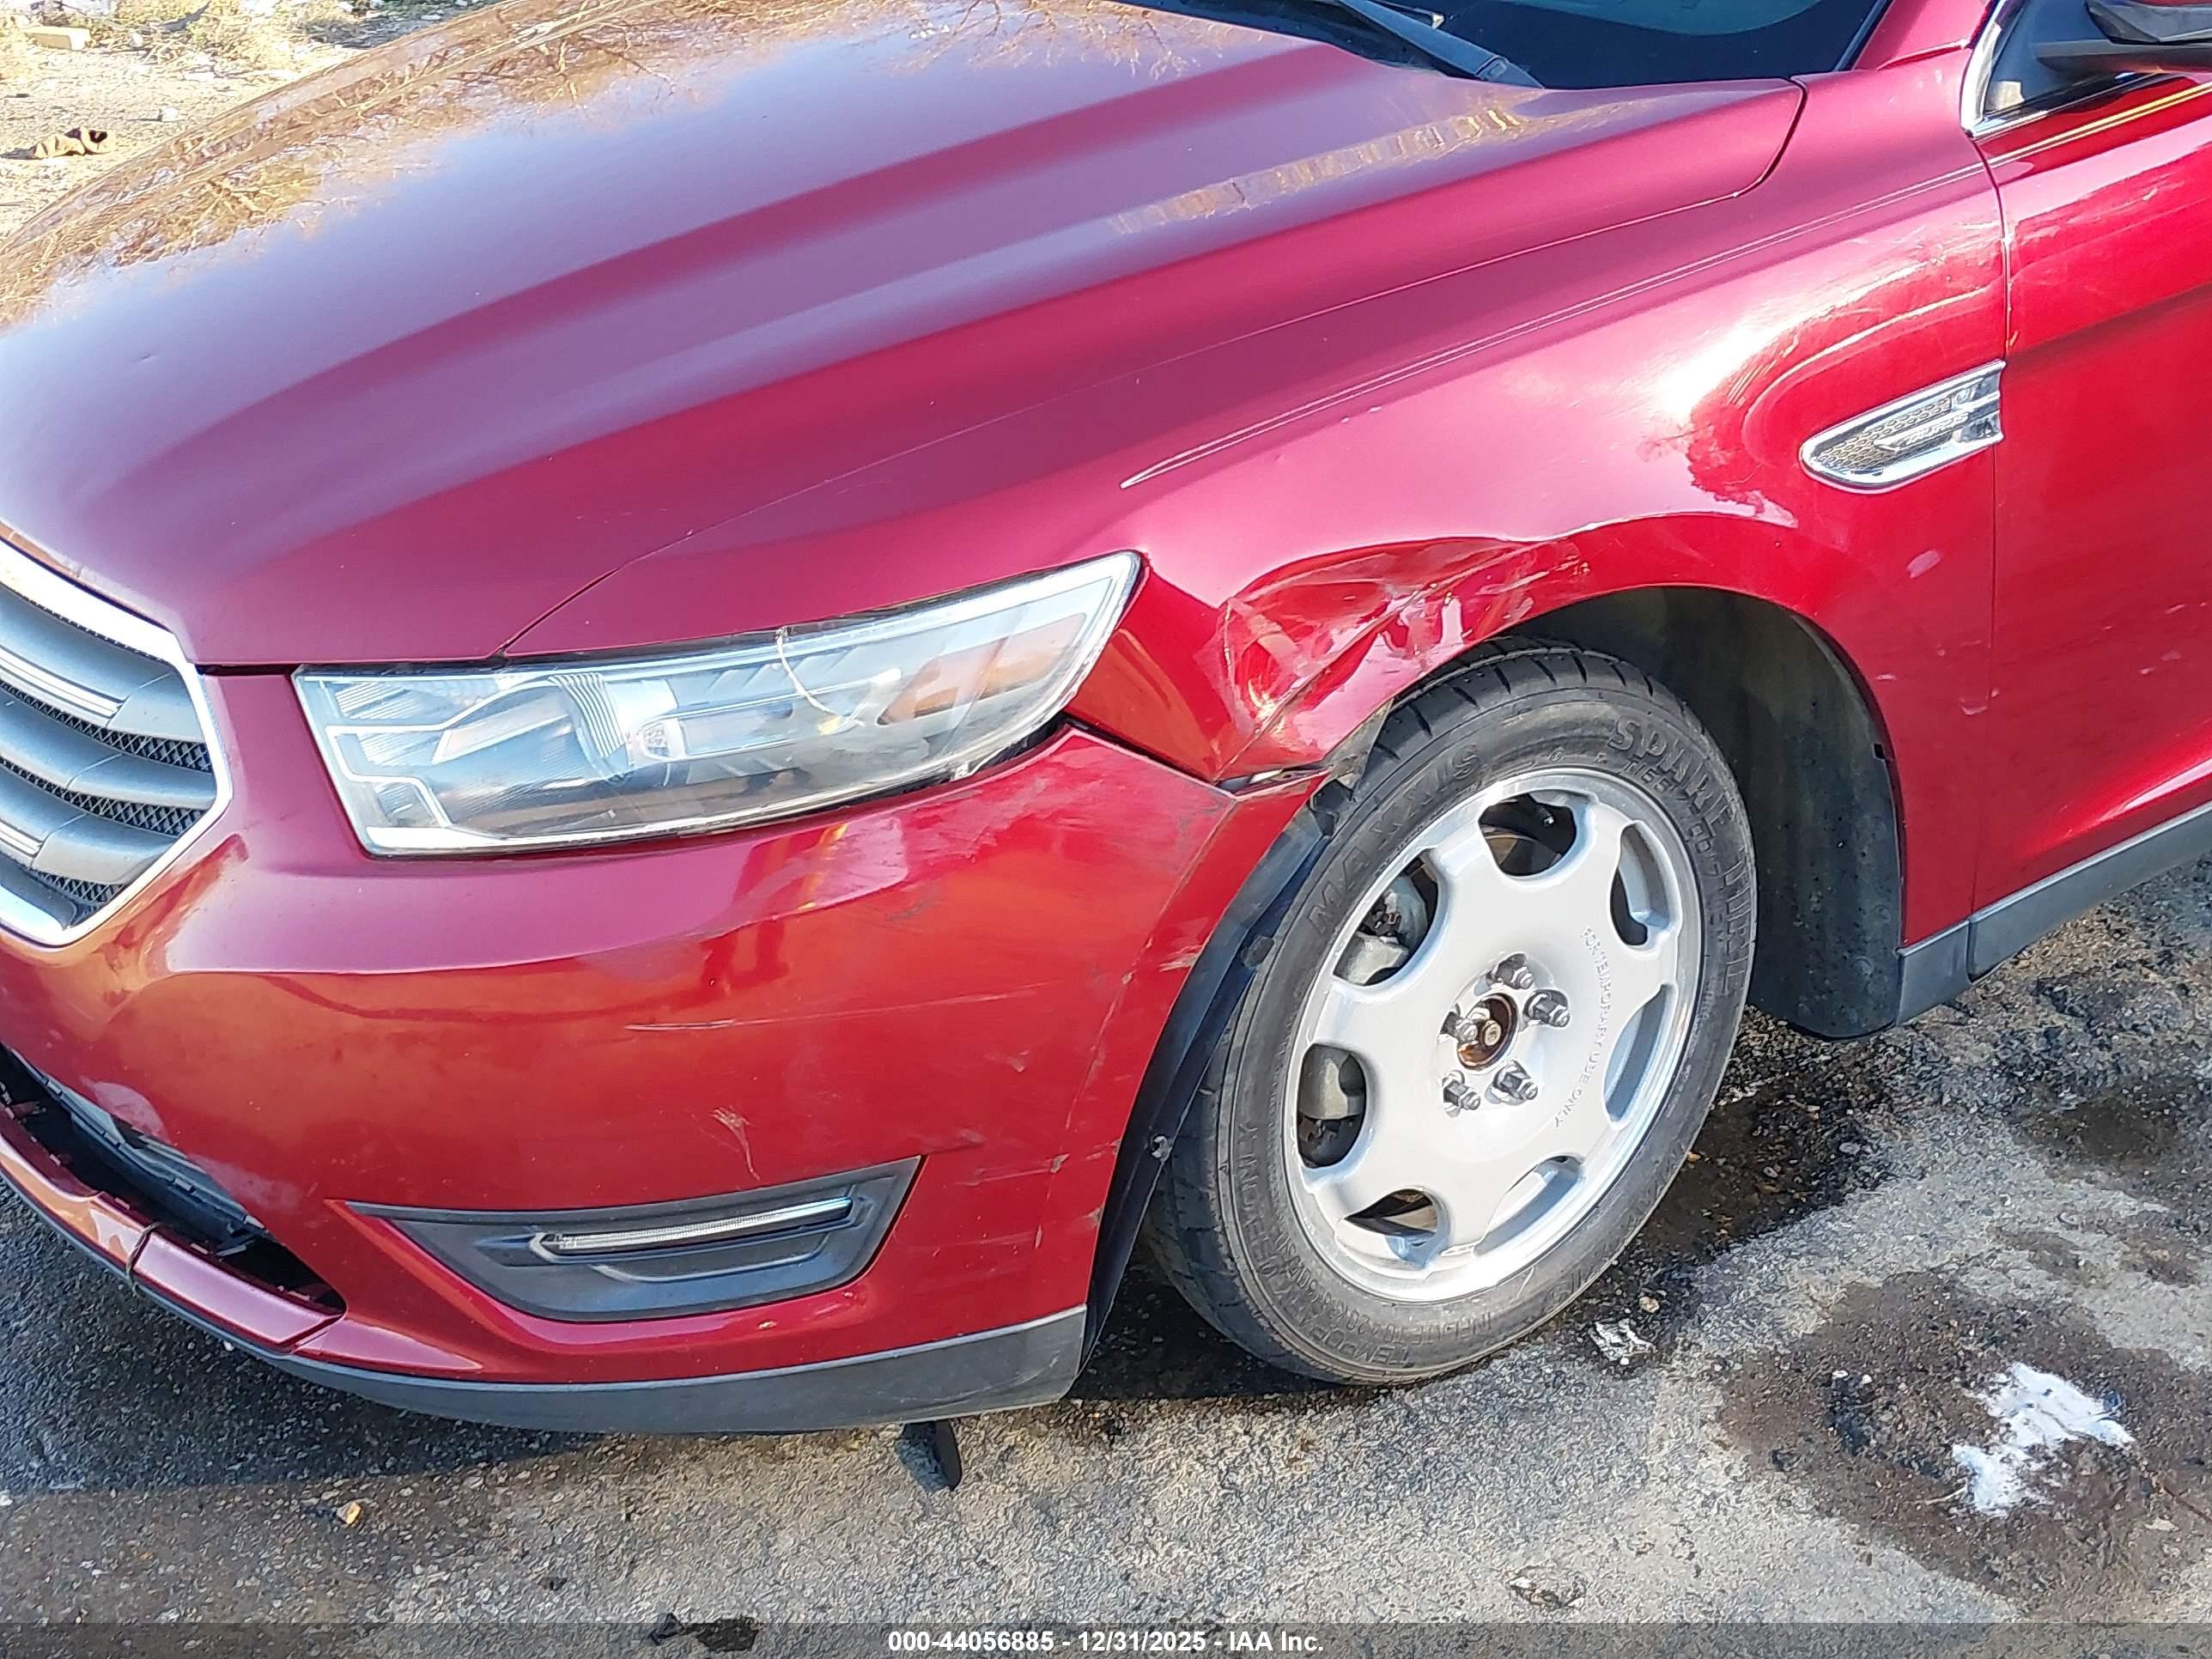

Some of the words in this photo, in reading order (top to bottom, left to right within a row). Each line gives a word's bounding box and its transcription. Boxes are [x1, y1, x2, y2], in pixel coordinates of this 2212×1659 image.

[1308, 744, 1478, 933] MAXXIS
[1607, 715, 1735, 829] SPARE
[1722, 852, 1751, 994] TIRE
[1580, 927, 1602, 955] FOR
[1579, 1052, 1601, 1085] USE
[1554, 1087, 1583, 1127] ONLY
[1237, 1118, 1260, 1213] ONLY
